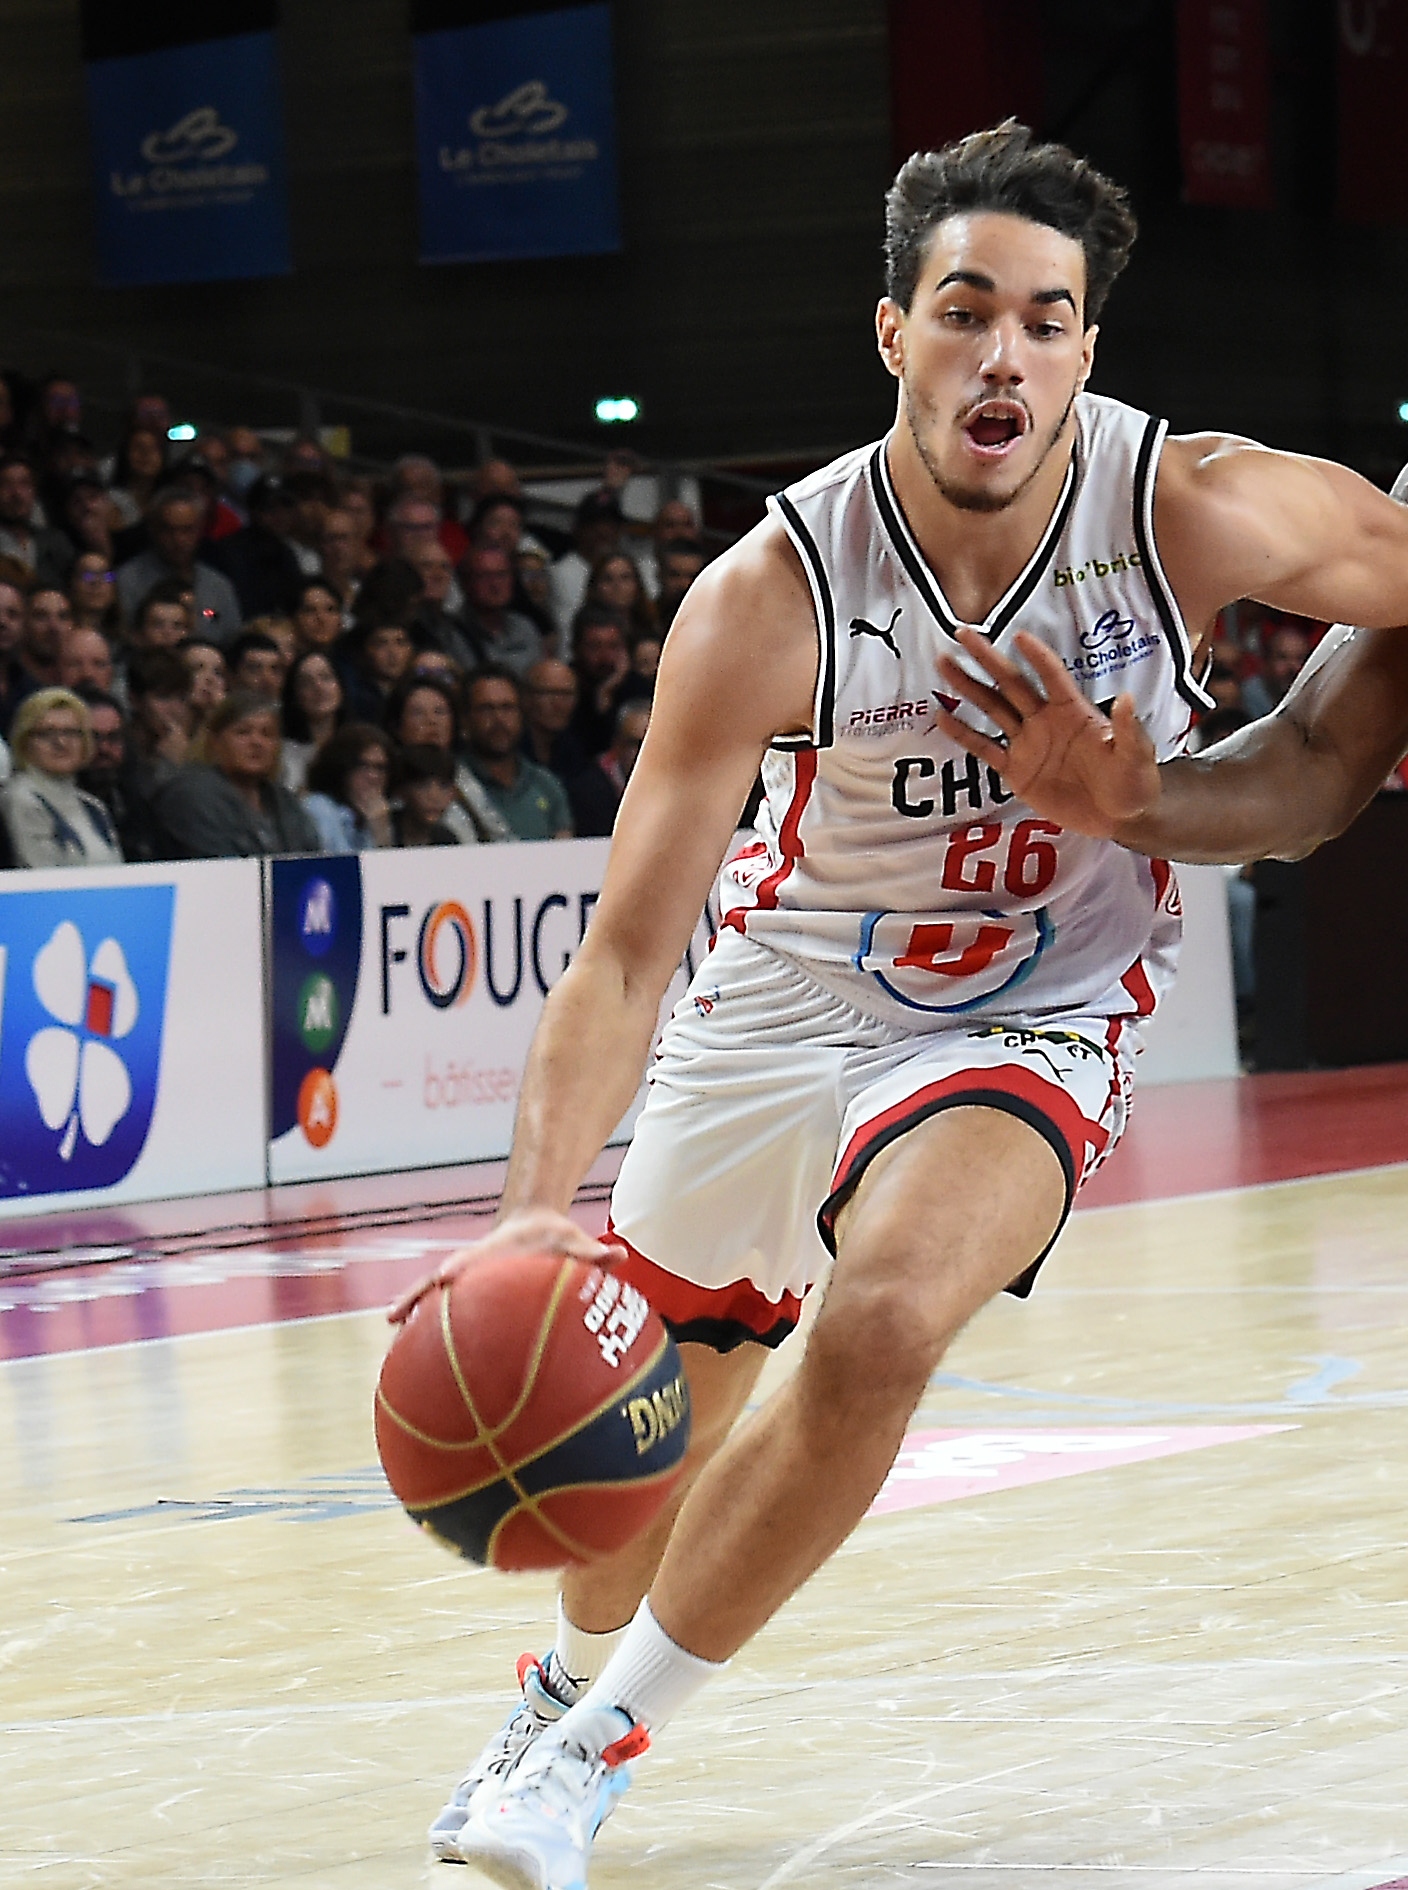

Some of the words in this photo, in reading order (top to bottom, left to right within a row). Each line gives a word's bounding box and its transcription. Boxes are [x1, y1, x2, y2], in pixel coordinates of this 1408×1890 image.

[1062, 657, 1084, 671] Le
[1086, 633, 1161, 668] Choletais
[941, 819, 1064, 899] 26
